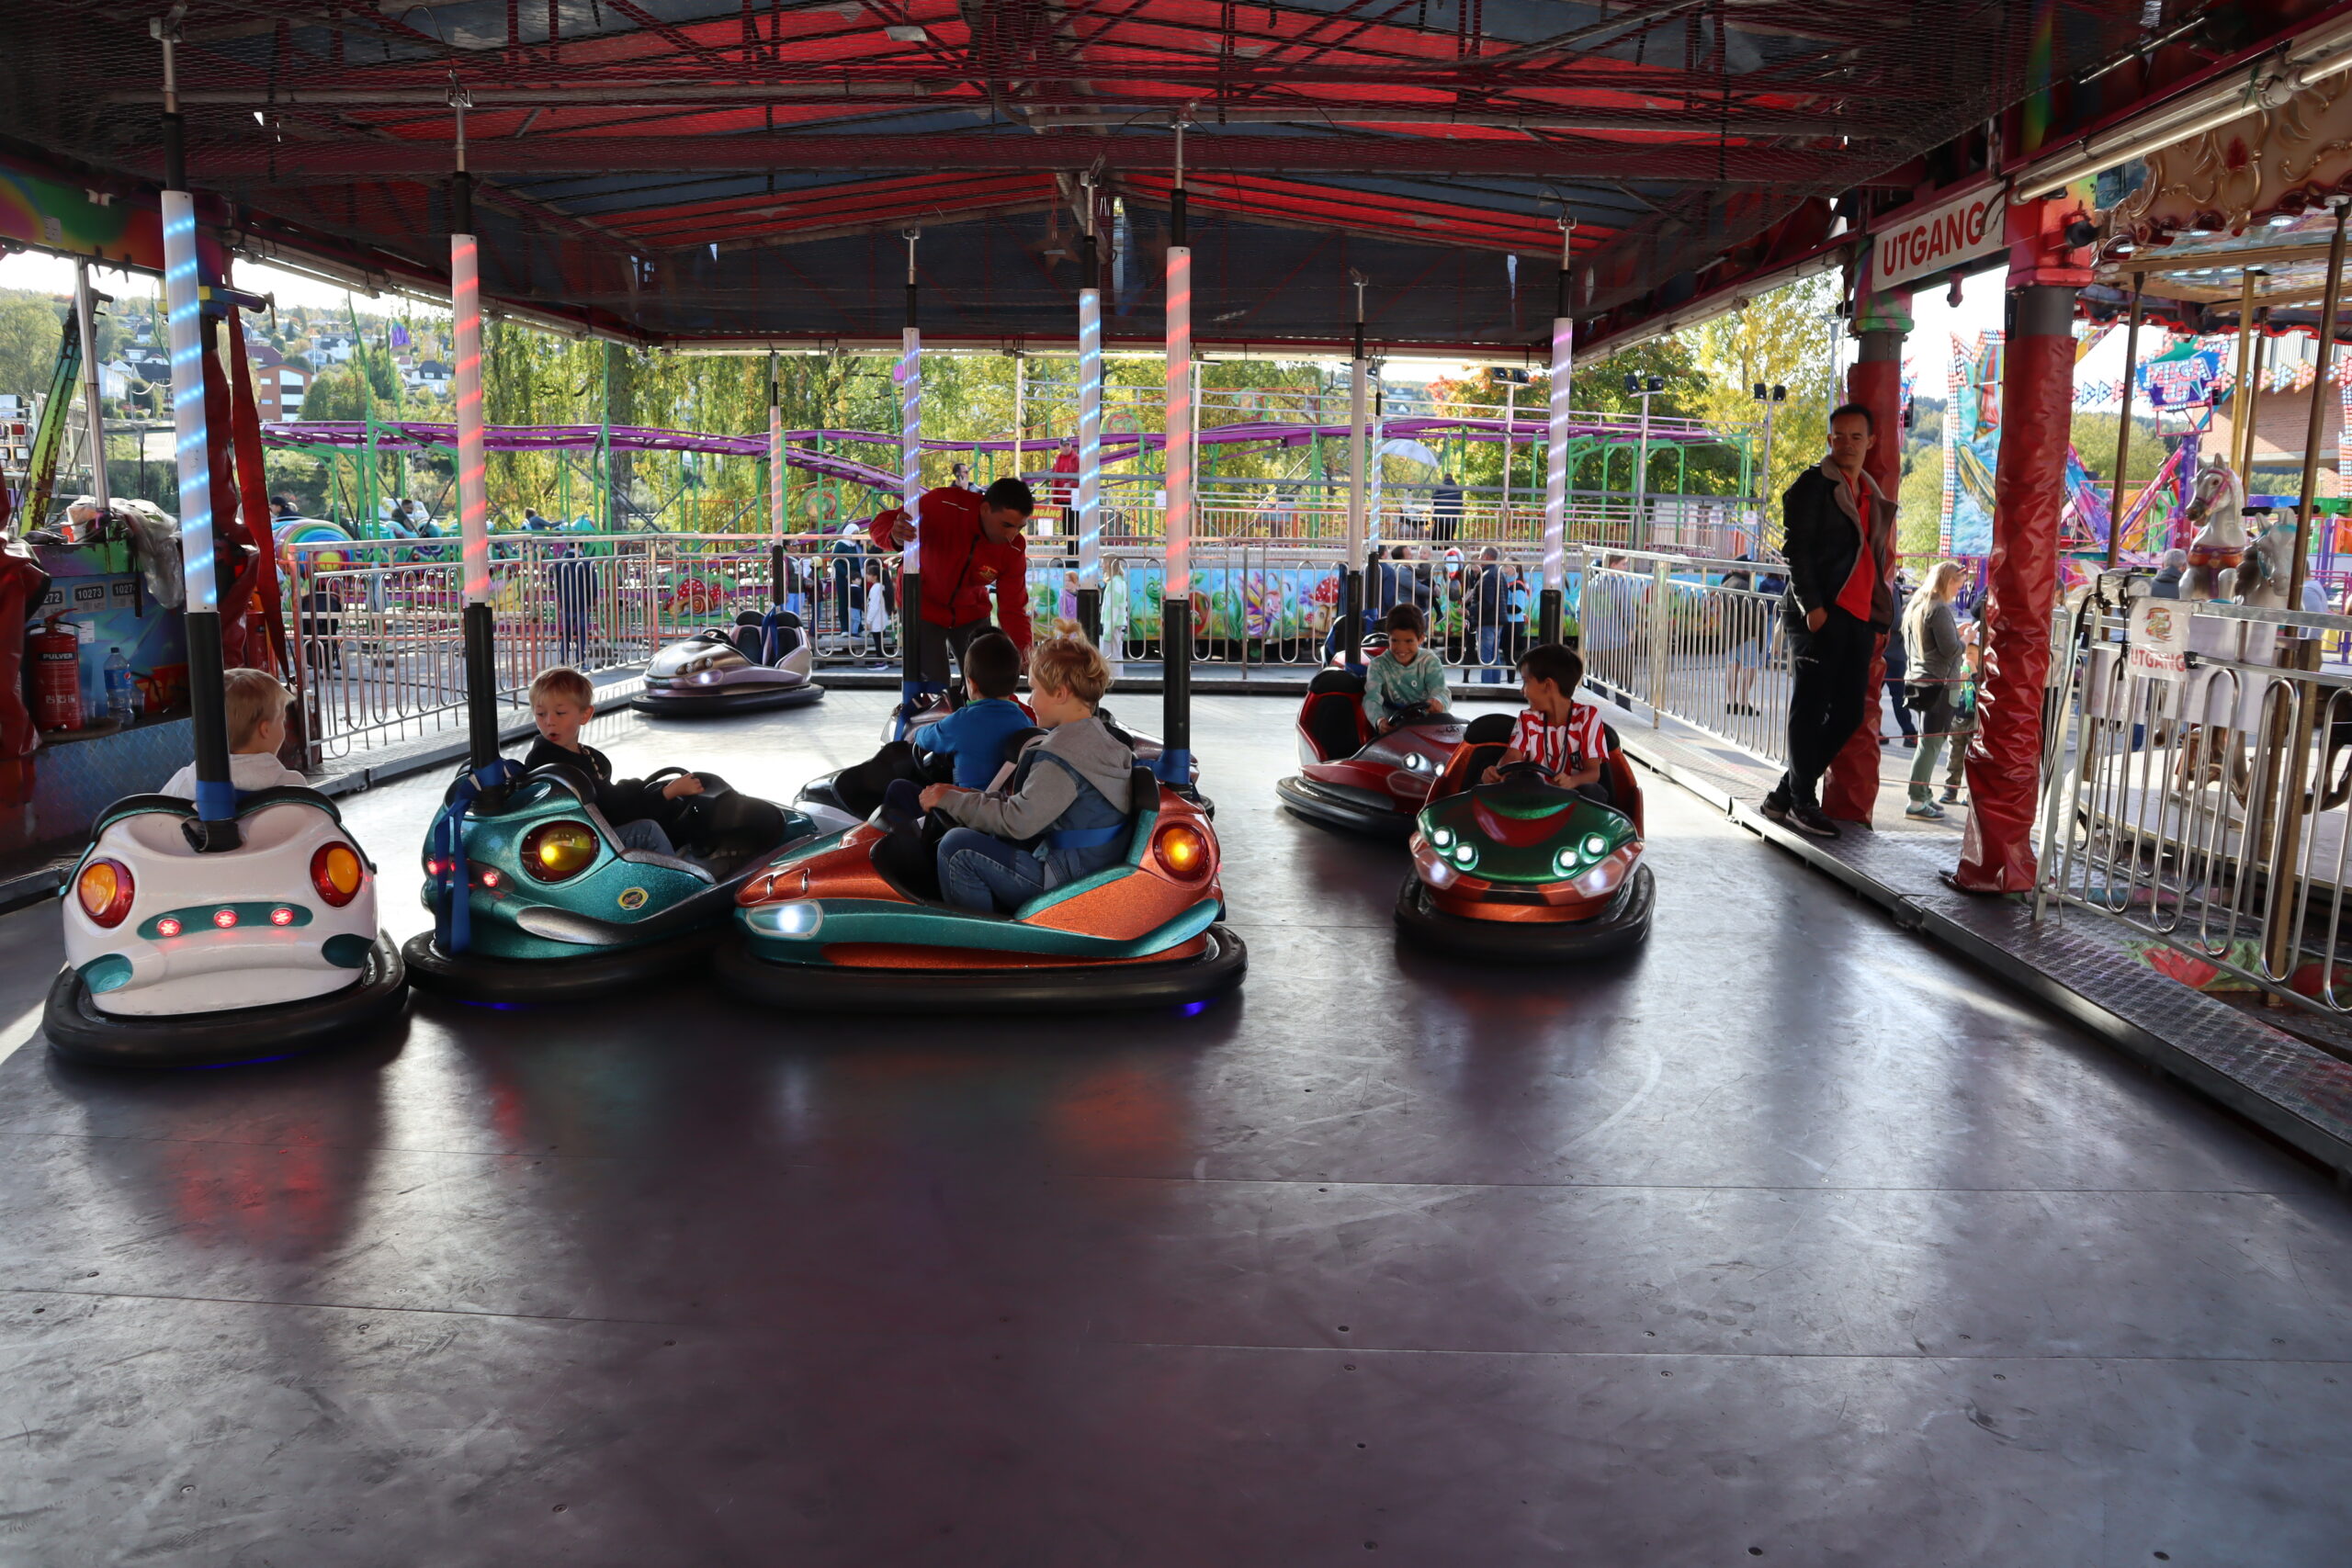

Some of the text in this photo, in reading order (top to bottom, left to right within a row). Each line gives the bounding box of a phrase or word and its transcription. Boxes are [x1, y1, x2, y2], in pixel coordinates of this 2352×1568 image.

[1883, 201, 1985, 276] UTGANG
[1030, 506, 1062, 518] NGÅNG
[77, 587, 103, 598] 10273
[115, 583, 137, 594] 1027
[43, 593, 61, 604] 272
[43, 652, 74, 660] PULVER
